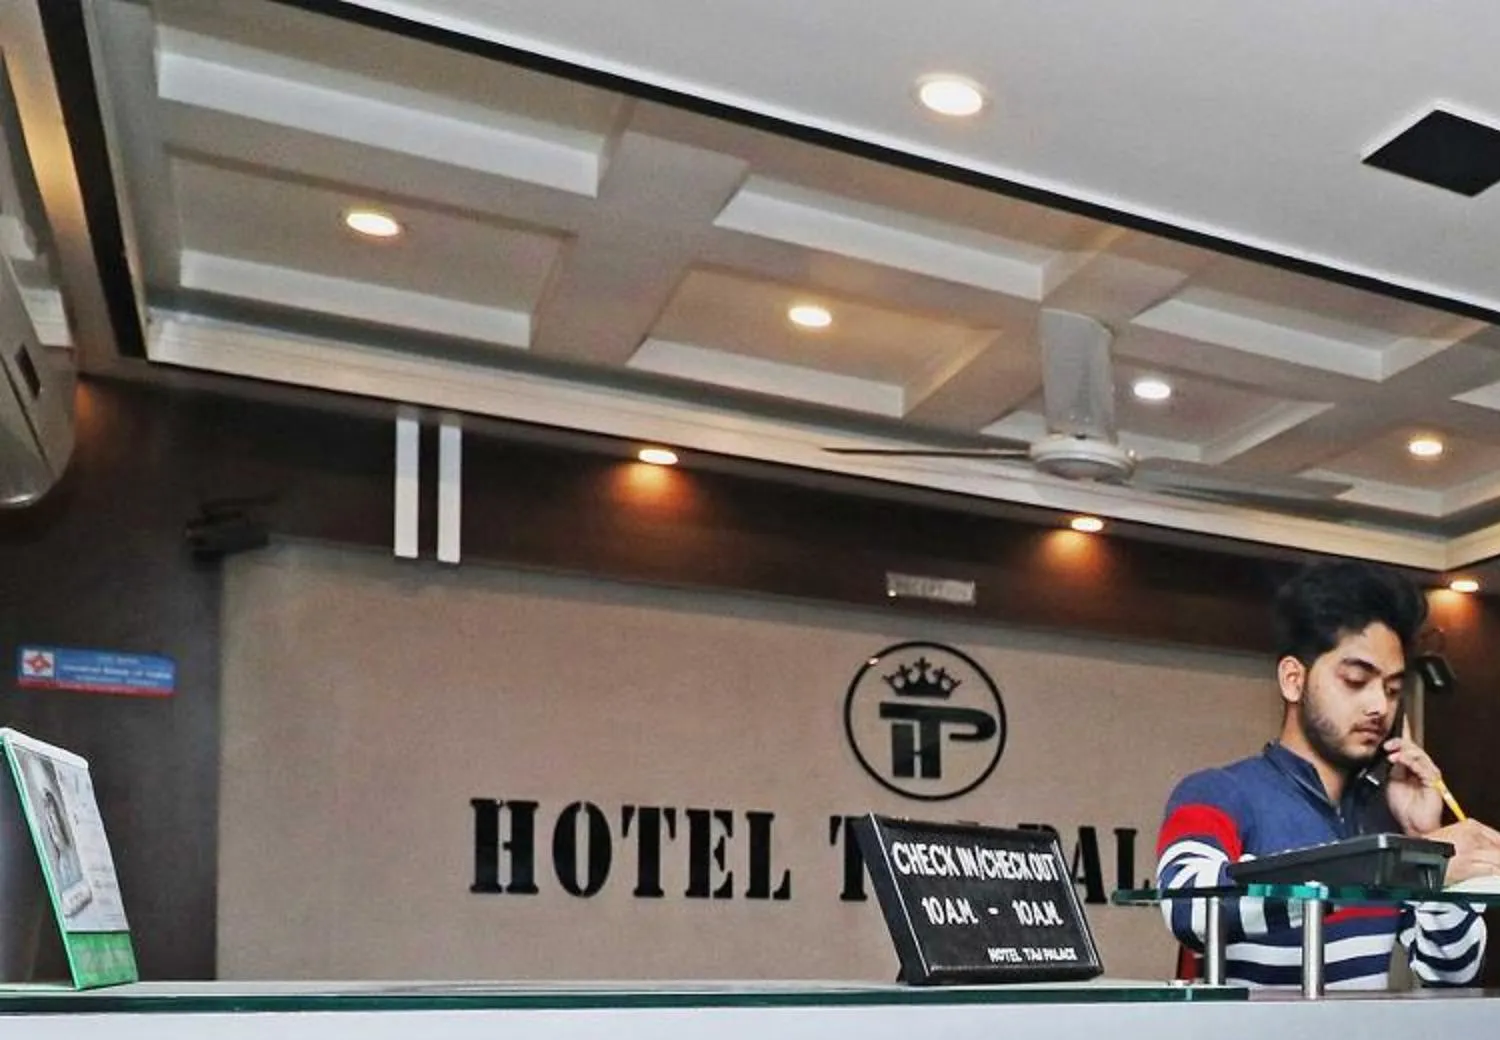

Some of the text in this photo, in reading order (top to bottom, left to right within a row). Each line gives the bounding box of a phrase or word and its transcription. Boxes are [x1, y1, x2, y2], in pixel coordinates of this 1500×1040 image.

[470, 798, 790, 898] HOTEL
[892, 842, 960, 877] CHECK
[1030, 853, 1059, 881] OUT
[922, 896, 945, 925] 10
[1012, 900, 1034, 926] 10
[987, 947, 1022, 963] HOTEL
